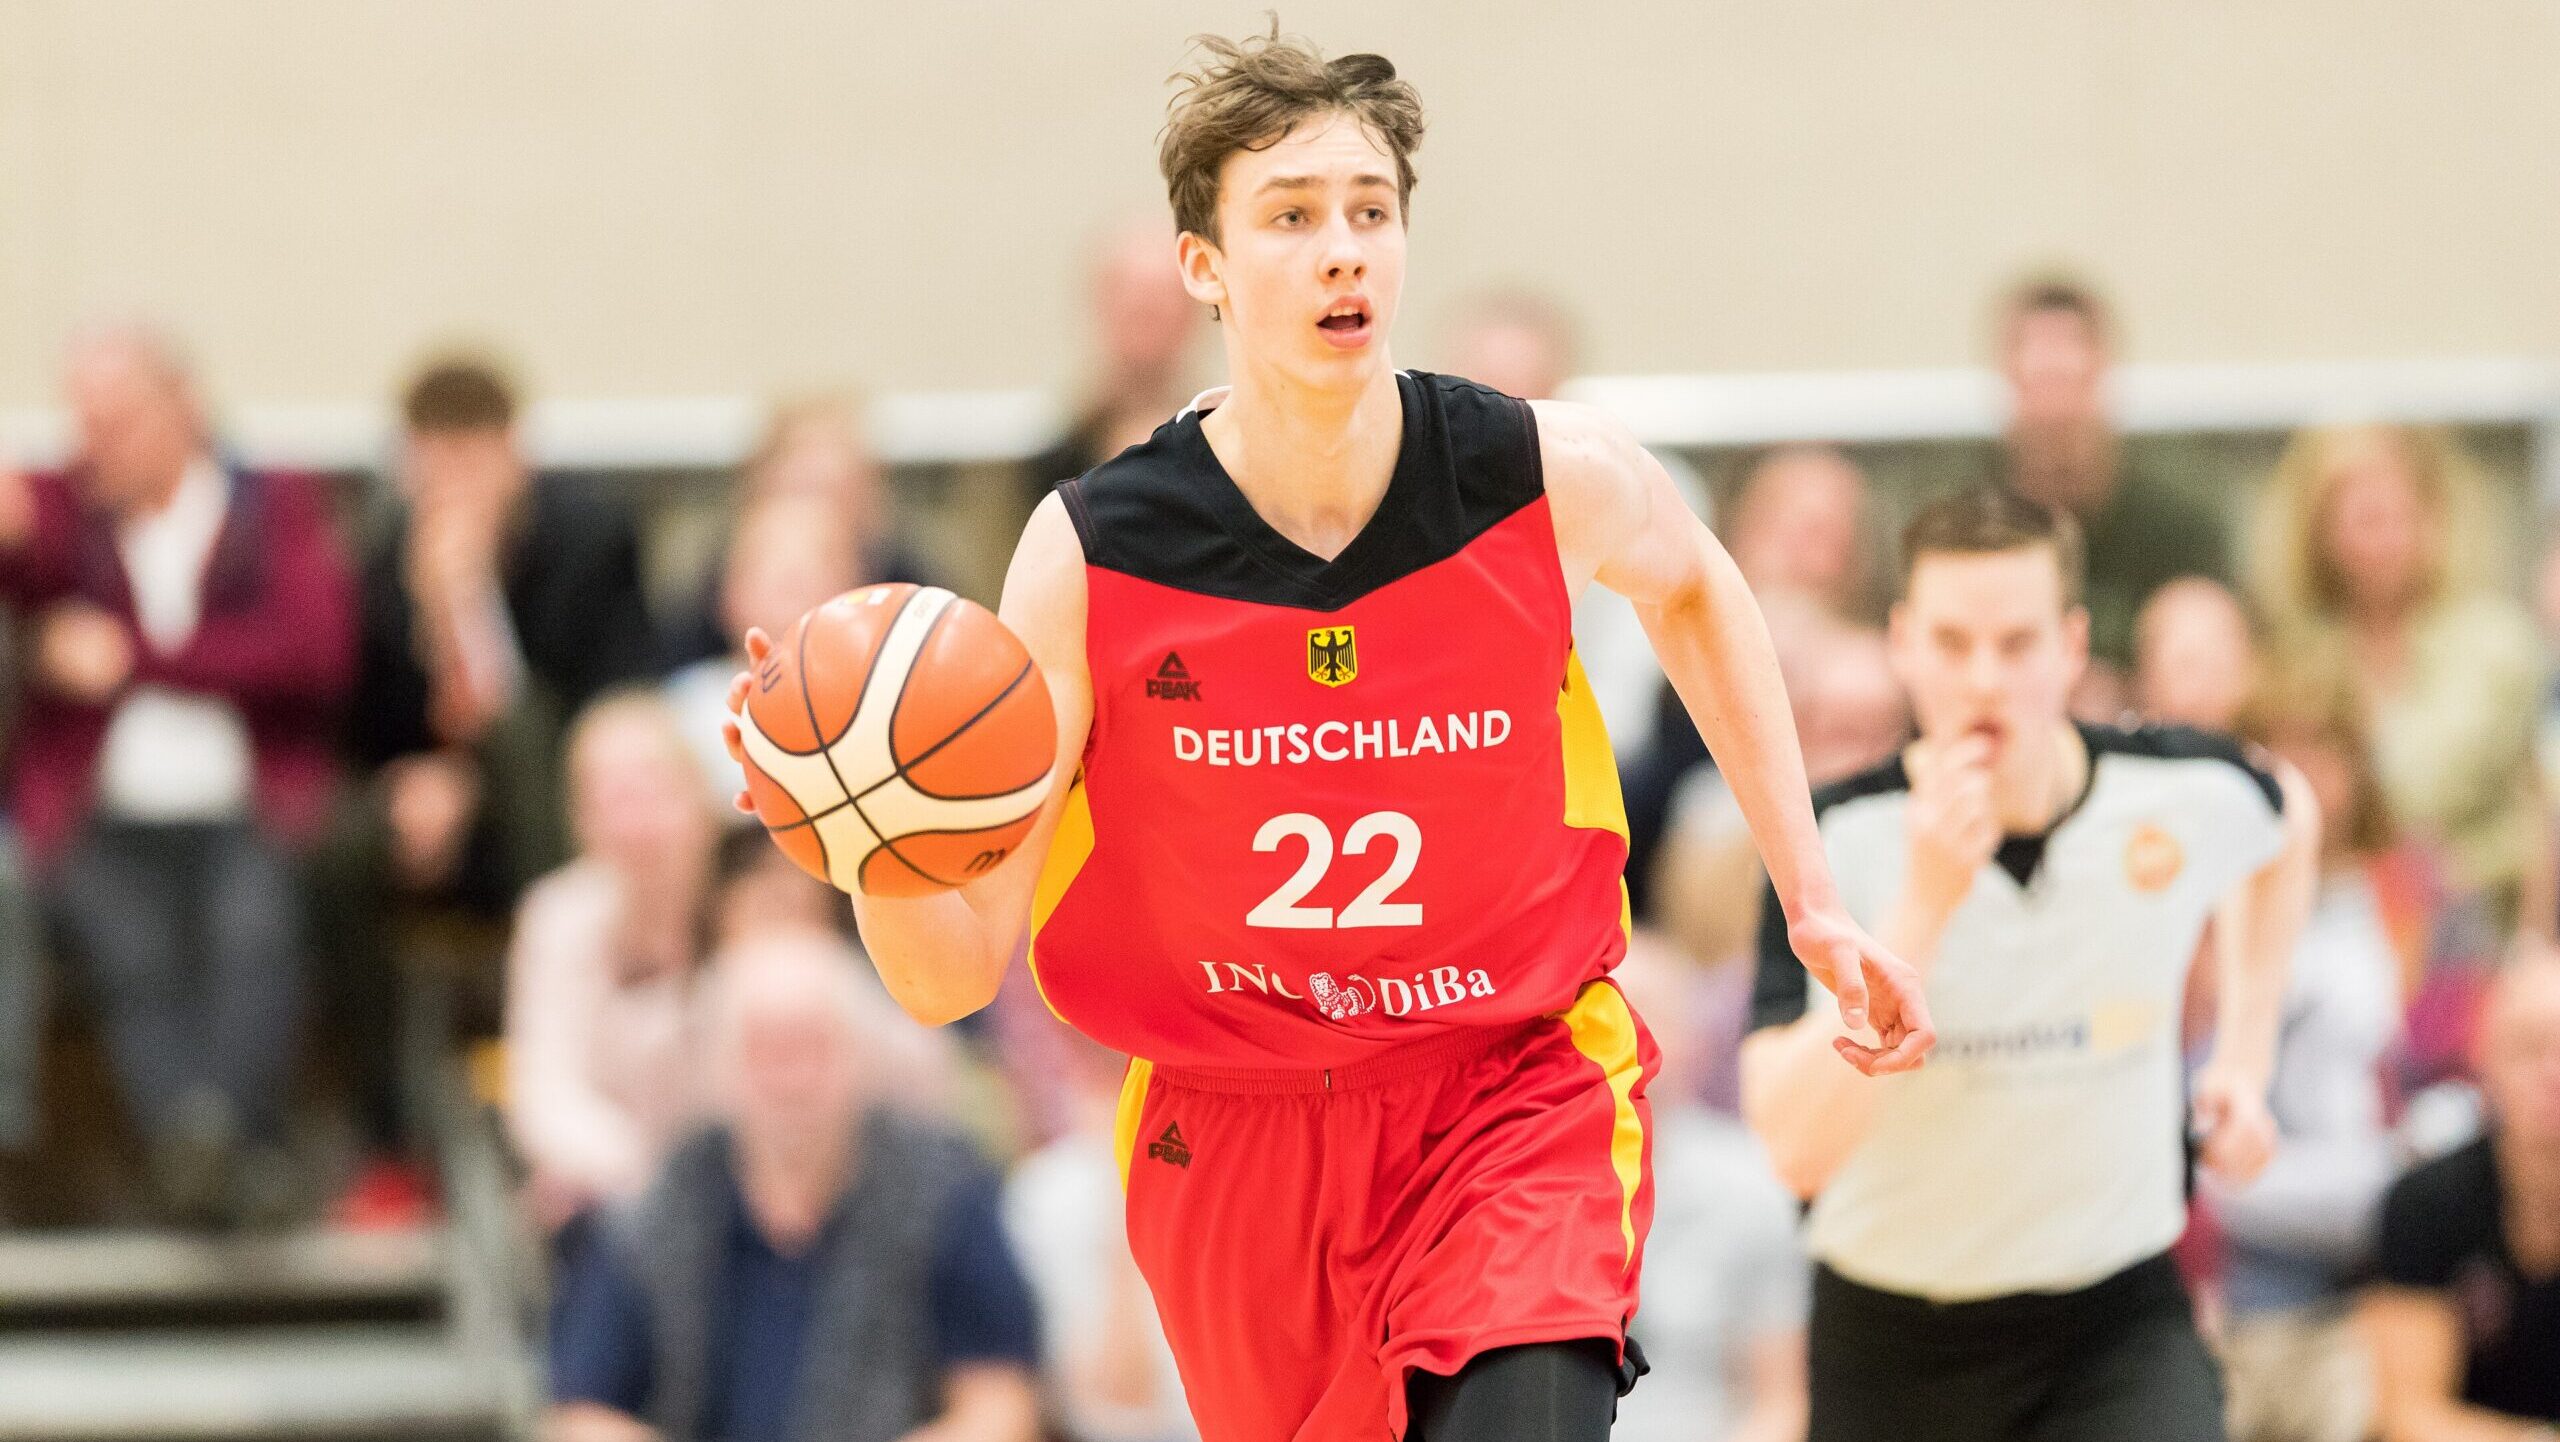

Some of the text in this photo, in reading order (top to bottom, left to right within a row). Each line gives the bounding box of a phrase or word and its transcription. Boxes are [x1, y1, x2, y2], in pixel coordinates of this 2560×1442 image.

[1145, 679, 1202, 702] PEAK
[1173, 709, 1512, 766] DEUTSCHLAND
[1246, 811, 1423, 928] 22
[1377, 965, 1497, 1016] DiBa
